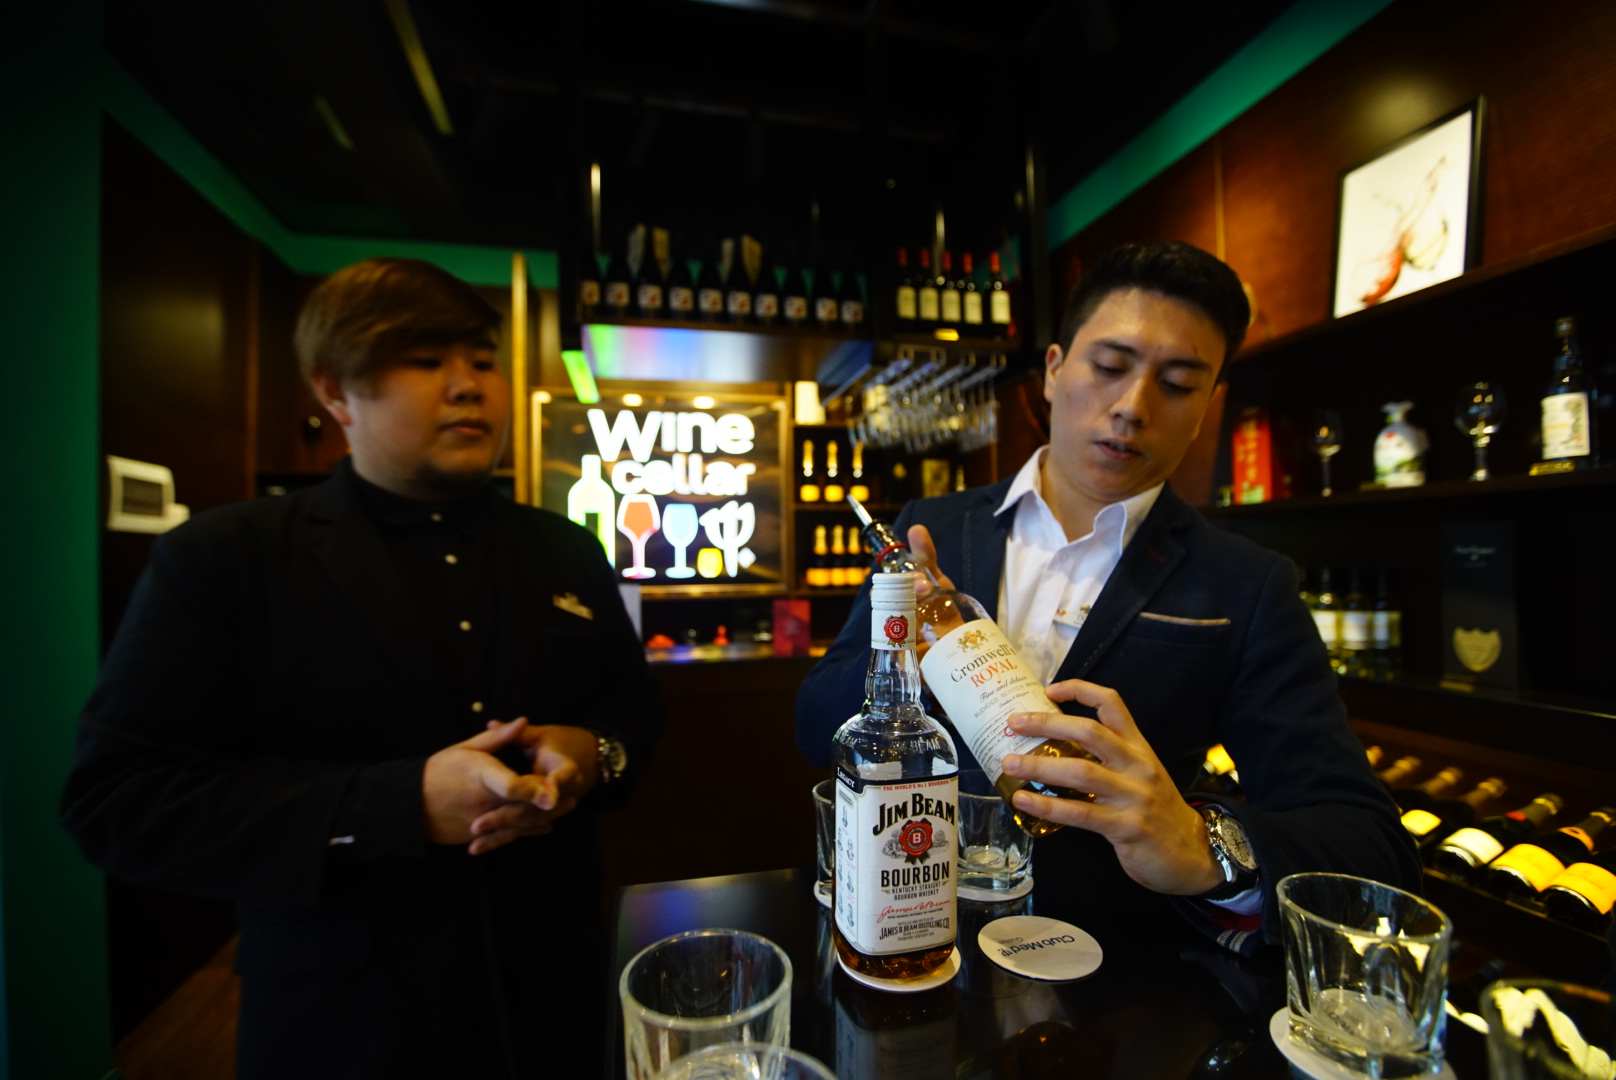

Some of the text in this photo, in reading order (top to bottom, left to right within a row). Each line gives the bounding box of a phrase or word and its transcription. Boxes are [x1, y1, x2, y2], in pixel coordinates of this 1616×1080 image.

[587, 408, 755, 463] Wine
[611, 453, 756, 495] cellar
[970, 658, 1018, 688] ROYAL
[996, 681, 1008, 692] and
[974, 697, 999, 719] BLENDED
[1000, 685, 1024, 699] SCOTCH
[894, 783, 916, 791] WORLD'S
[928, 779, 949, 787] BOURBON
[873, 793, 955, 836] JIM BEAM
[913, 832, 921, 844] B
[881, 861, 950, 888] BOURBON
[892, 881, 940, 894] KENTUCKY STRAIGHT
[894, 888, 939, 901] BOURBON WHISKEY
[879, 926, 899, 940] JAMES
[904, 923, 917, 933] BEAM
[918, 918, 943, 929] DISTILLING
